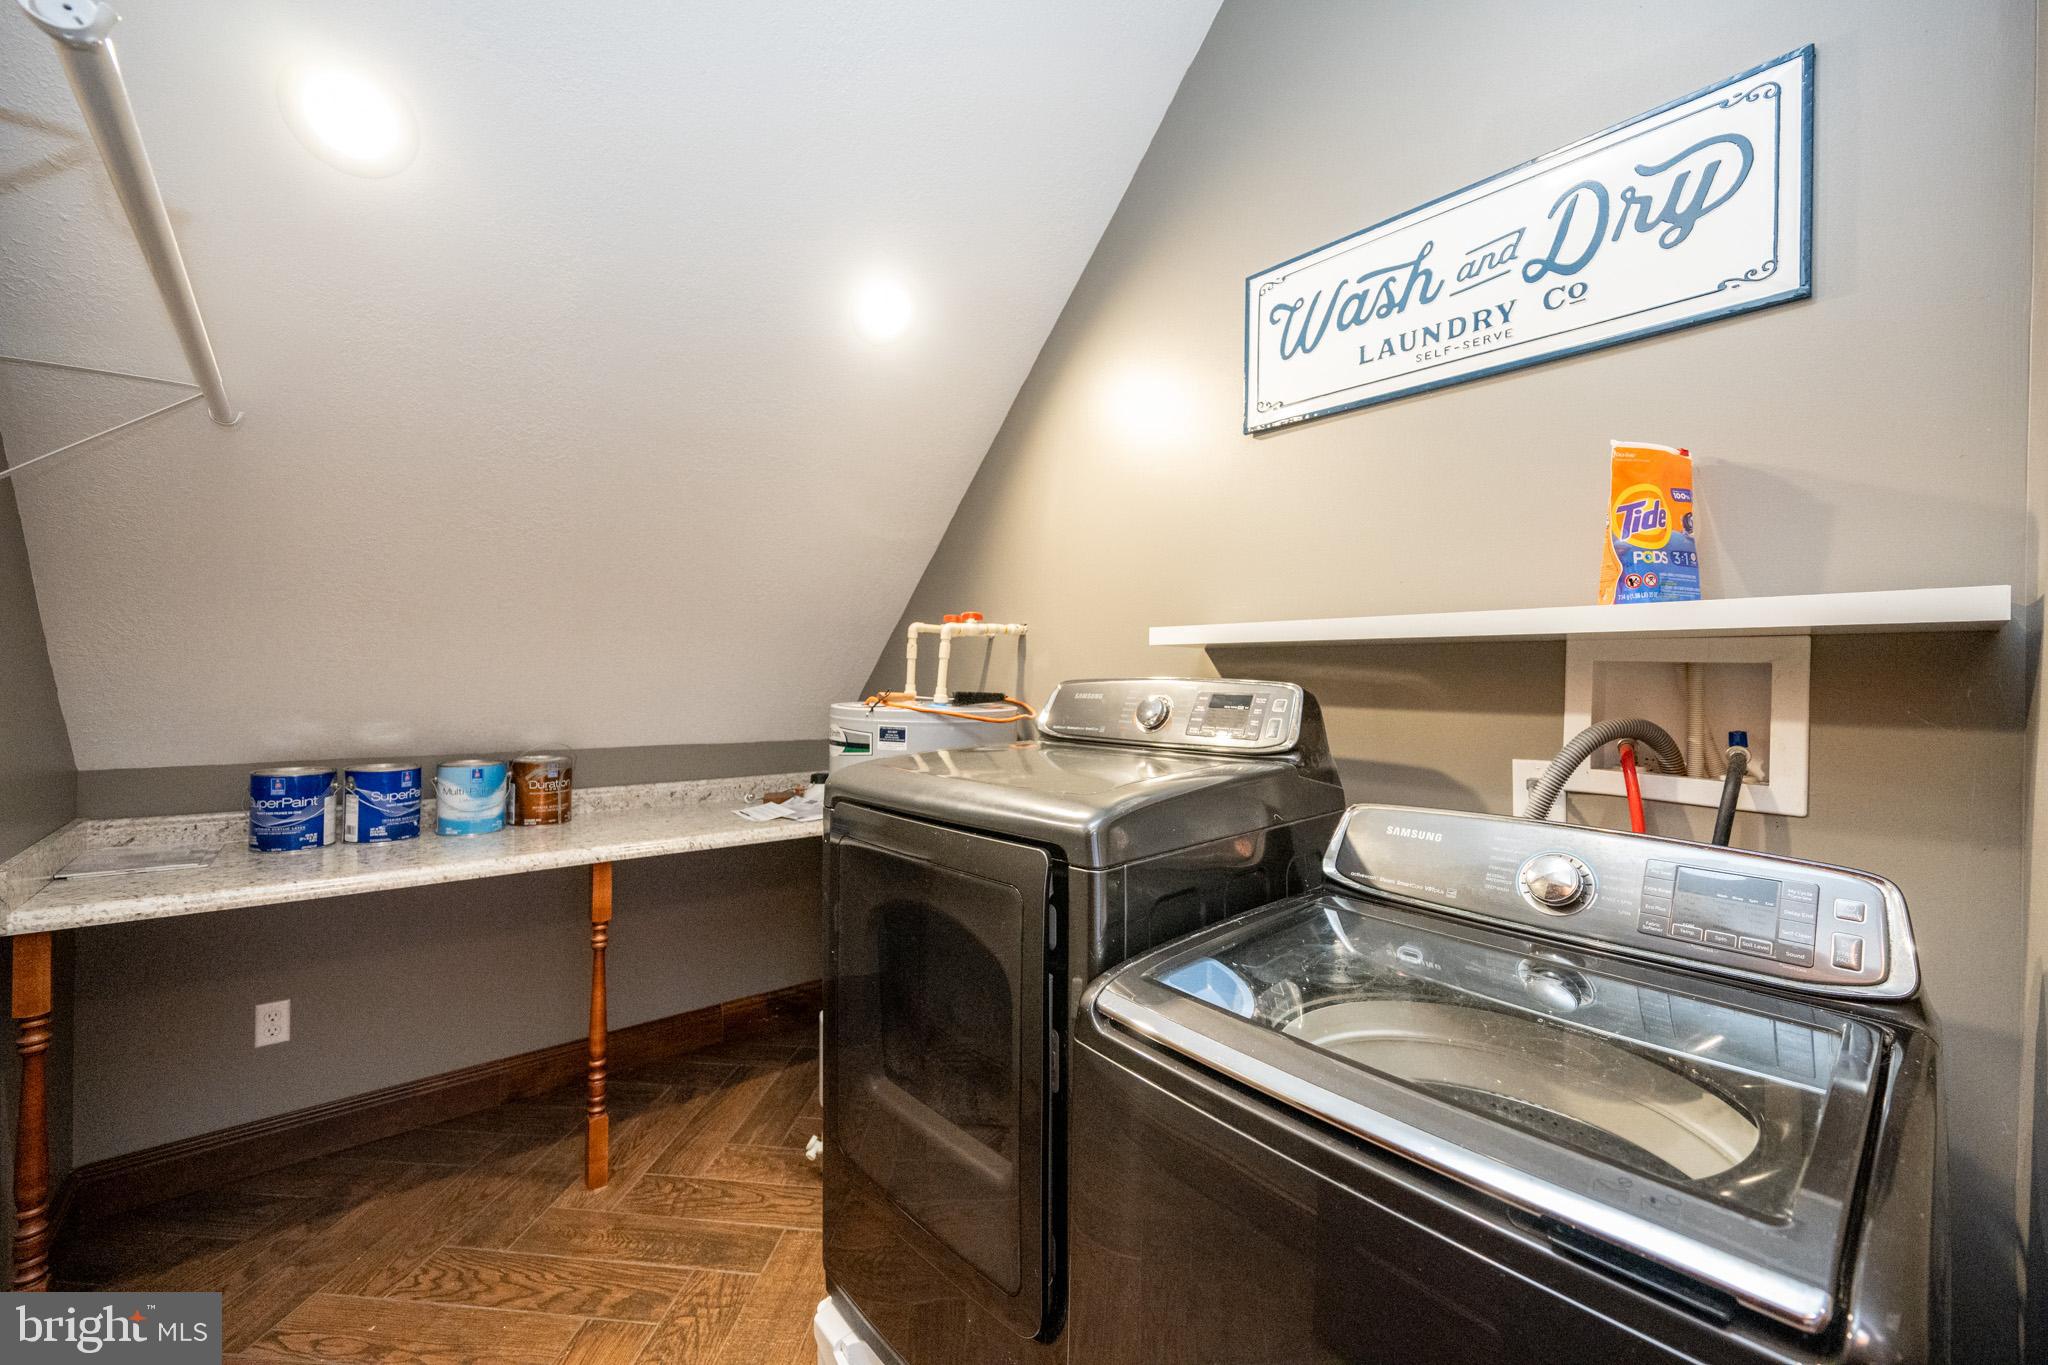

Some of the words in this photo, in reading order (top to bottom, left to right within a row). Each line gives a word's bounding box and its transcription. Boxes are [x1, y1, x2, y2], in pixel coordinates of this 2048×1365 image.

[1269, 240, 1445, 361] Wash
[1457, 227, 1527, 283] and
[1522, 132, 1755, 284] Dry
[1359, 299, 1517, 365] LAUNDRY
[1415, 328, 1513, 363] SELF-SERVE
[1616, 499, 1667, 542] Tide
[1632, 550, 1669, 565] PODS
[1386, 825, 1443, 842] SAMSUNG
[1785, 951, 1806, 960] Sound
